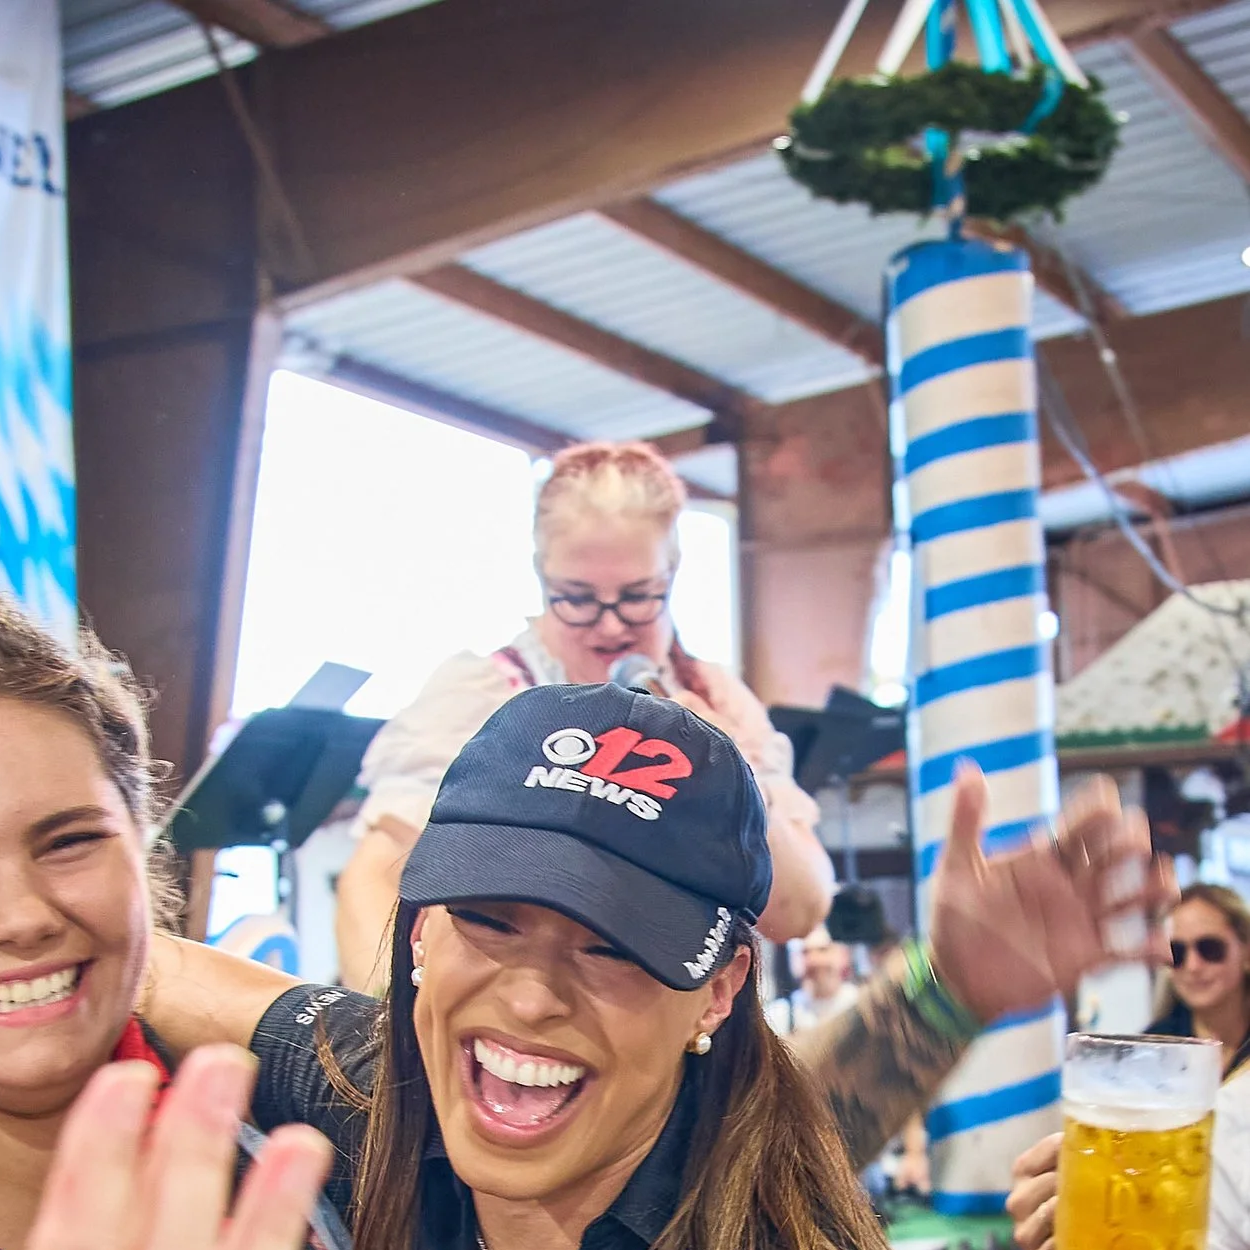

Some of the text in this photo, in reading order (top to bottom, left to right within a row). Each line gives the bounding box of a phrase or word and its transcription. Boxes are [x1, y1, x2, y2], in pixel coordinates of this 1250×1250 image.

[580, 726, 694, 800] 12
[523, 765, 663, 821] NEWS
[295, 990, 347, 1025] NEWS
